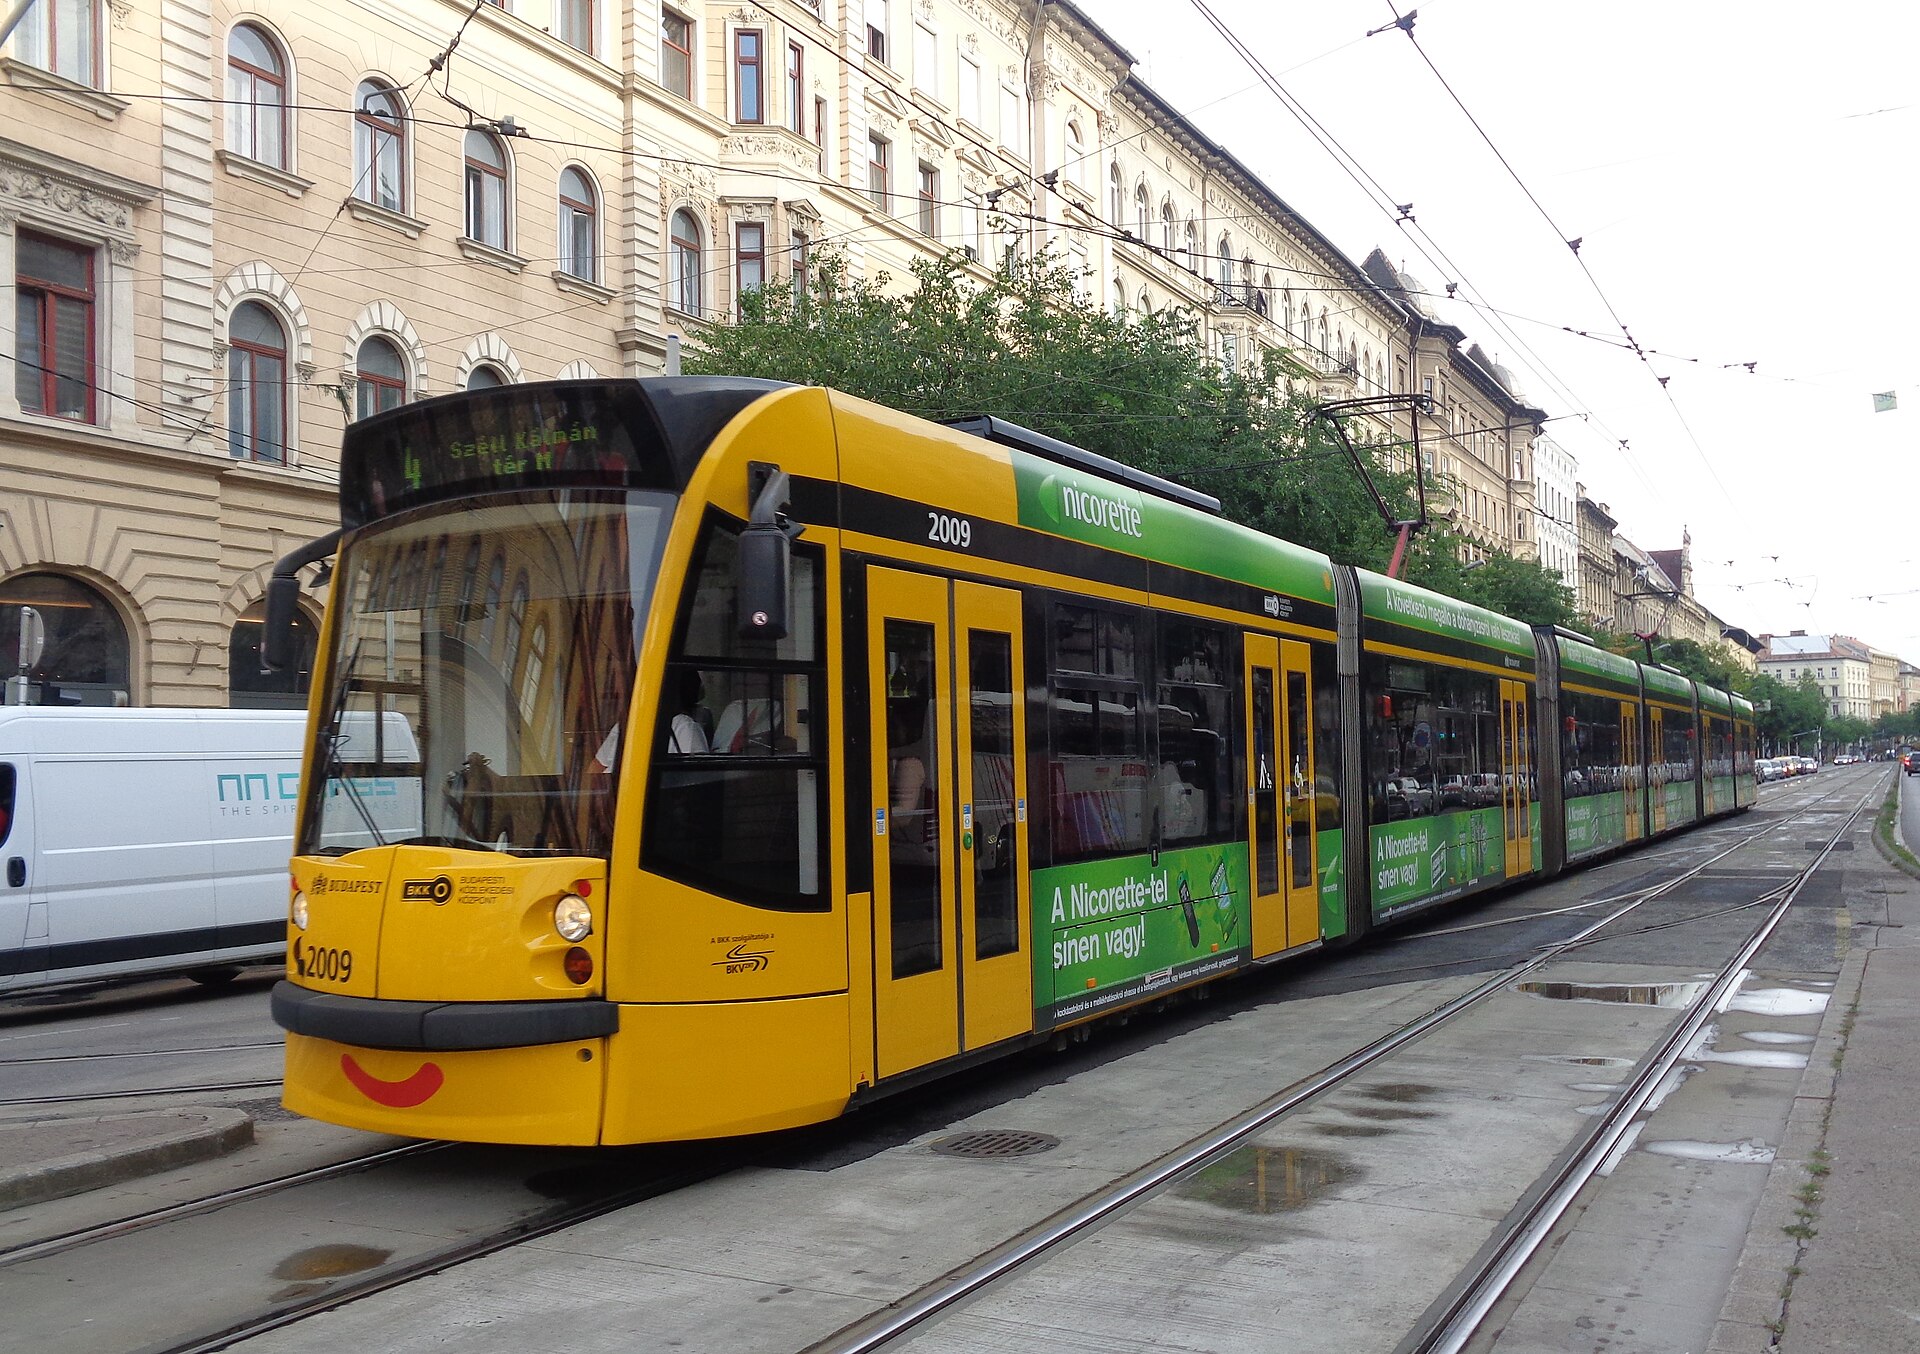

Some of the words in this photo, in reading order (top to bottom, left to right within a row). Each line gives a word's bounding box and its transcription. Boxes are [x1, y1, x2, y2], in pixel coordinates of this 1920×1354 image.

[451, 434, 507, 459] Széll
[514, 421, 597, 449] Kálmán
[404, 447, 422, 490] 4
[493, 454, 528, 475] tér
[1062, 480, 1143, 538] nicorette
[927, 511, 971, 548] 2009
[1386, 588, 1393, 610] A
[220, 806, 251, 817] THE
[1377, 836, 1384, 862] A
[1385, 828, 1429, 860] Nicorette-tel
[328, 878, 383, 894] BUDAPEST
[406, 884, 431, 896] BKK
[1378, 864, 1399, 890] sínen
[1399, 857, 1419, 887] vagy!
[1051, 886, 1066, 924] A
[1070, 869, 1168, 920] Nicorette-tel
[1053, 930, 1100, 969] sínen
[1104, 914, 1146, 959] vagy!
[305, 945, 353, 983] 2009
[726, 964, 745, 974] BKV
